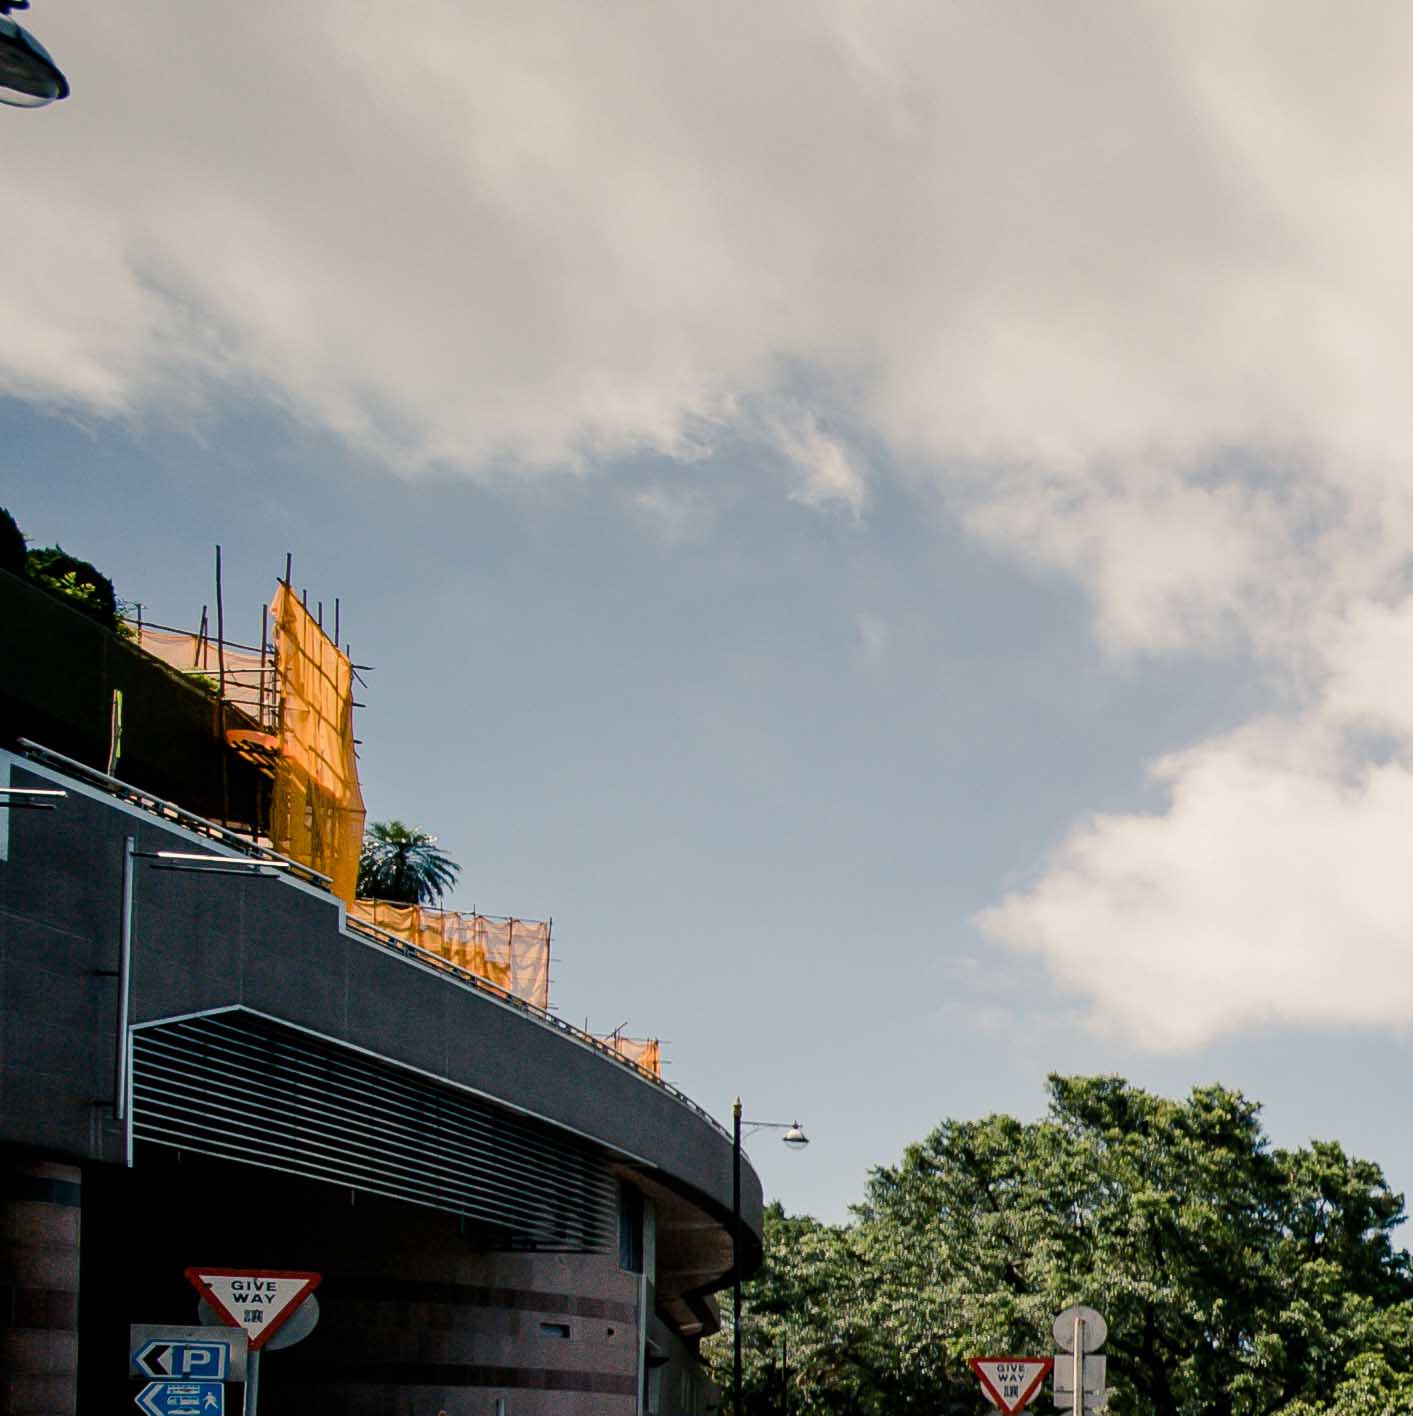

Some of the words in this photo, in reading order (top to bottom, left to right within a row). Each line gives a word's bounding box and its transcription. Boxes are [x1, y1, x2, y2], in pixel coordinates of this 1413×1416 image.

[231, 1280, 277, 1292] GIVE
[232, 1293, 276, 1304] WAY
[182, 1349, 211, 1373] P
[996, 1364, 1025, 1372] GIVE
[998, 1373, 1025, 1382] WAY
